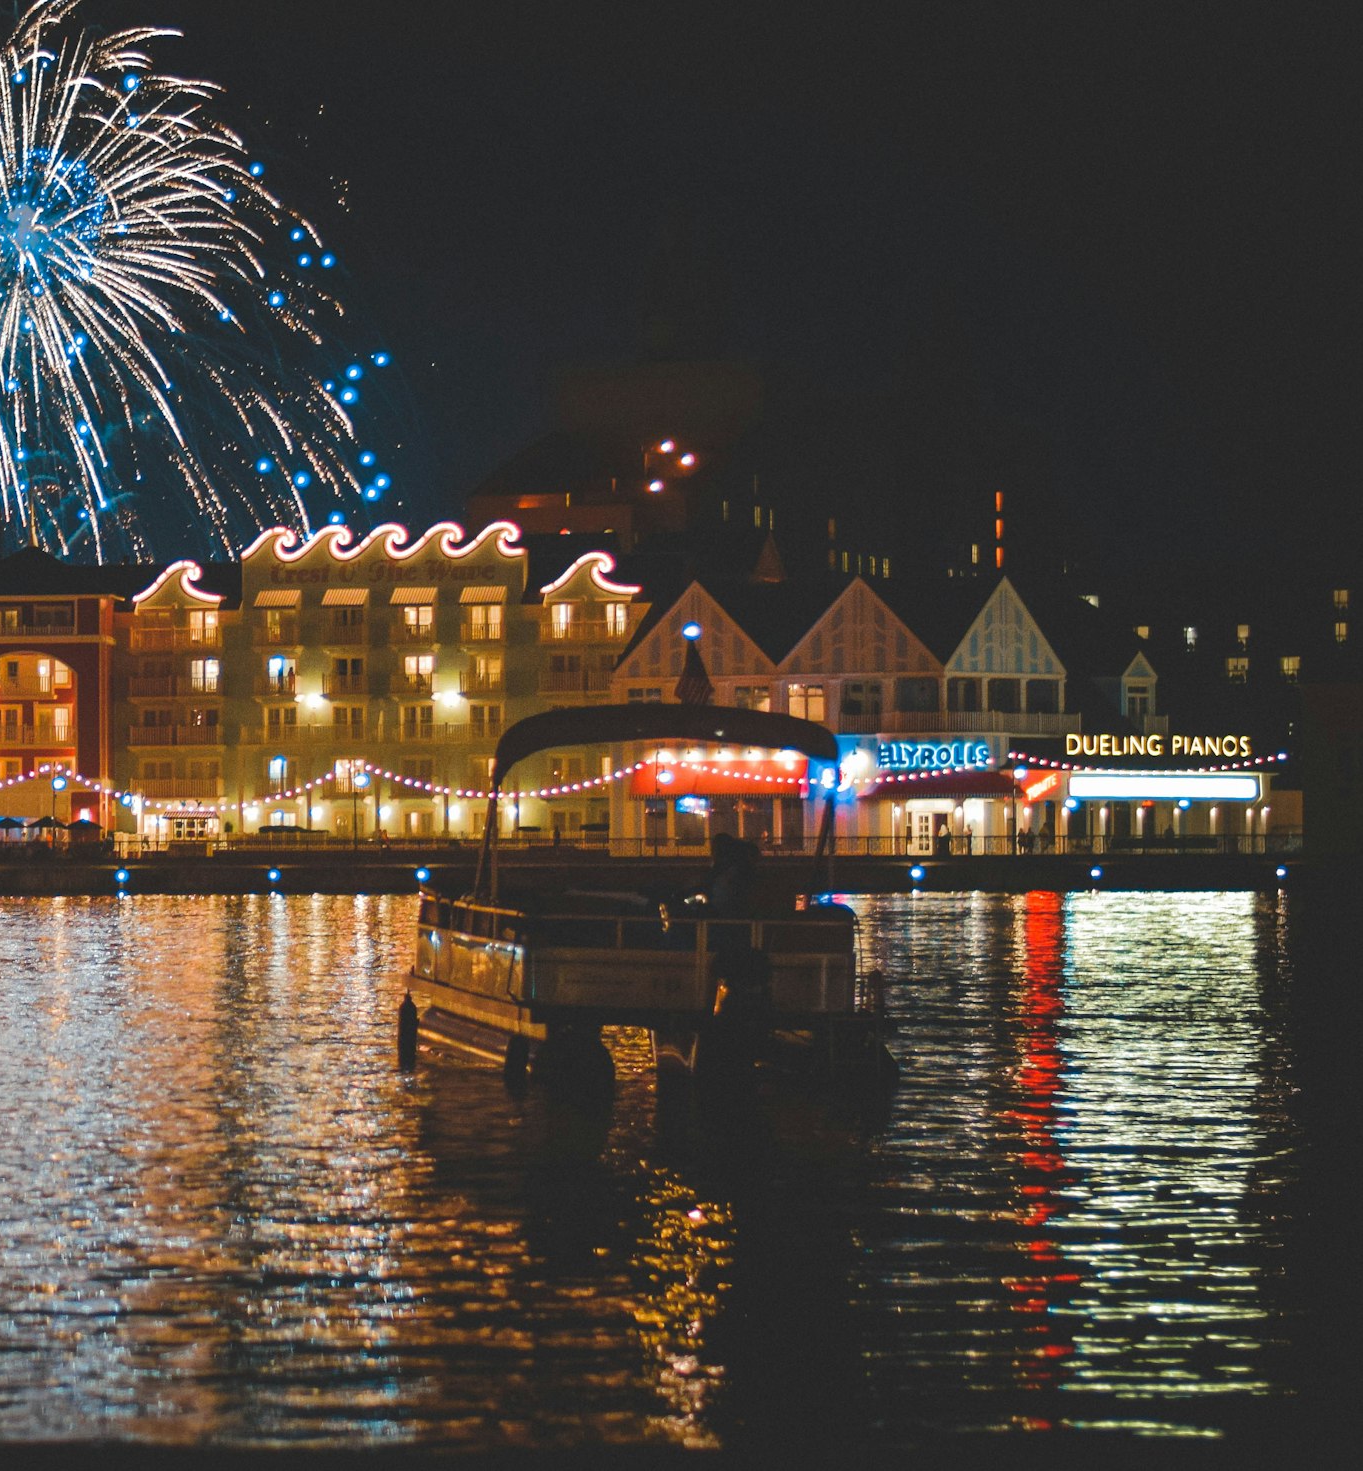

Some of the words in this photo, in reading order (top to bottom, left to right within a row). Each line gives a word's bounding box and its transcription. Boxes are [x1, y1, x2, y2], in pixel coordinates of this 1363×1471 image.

[270, 563, 330, 584] Crest
[368, 559, 418, 583] The
[428, 560, 496, 582] Wave
[1066, 734, 1163, 756] DUELING
[1172, 735, 1251, 757] PIANOS
